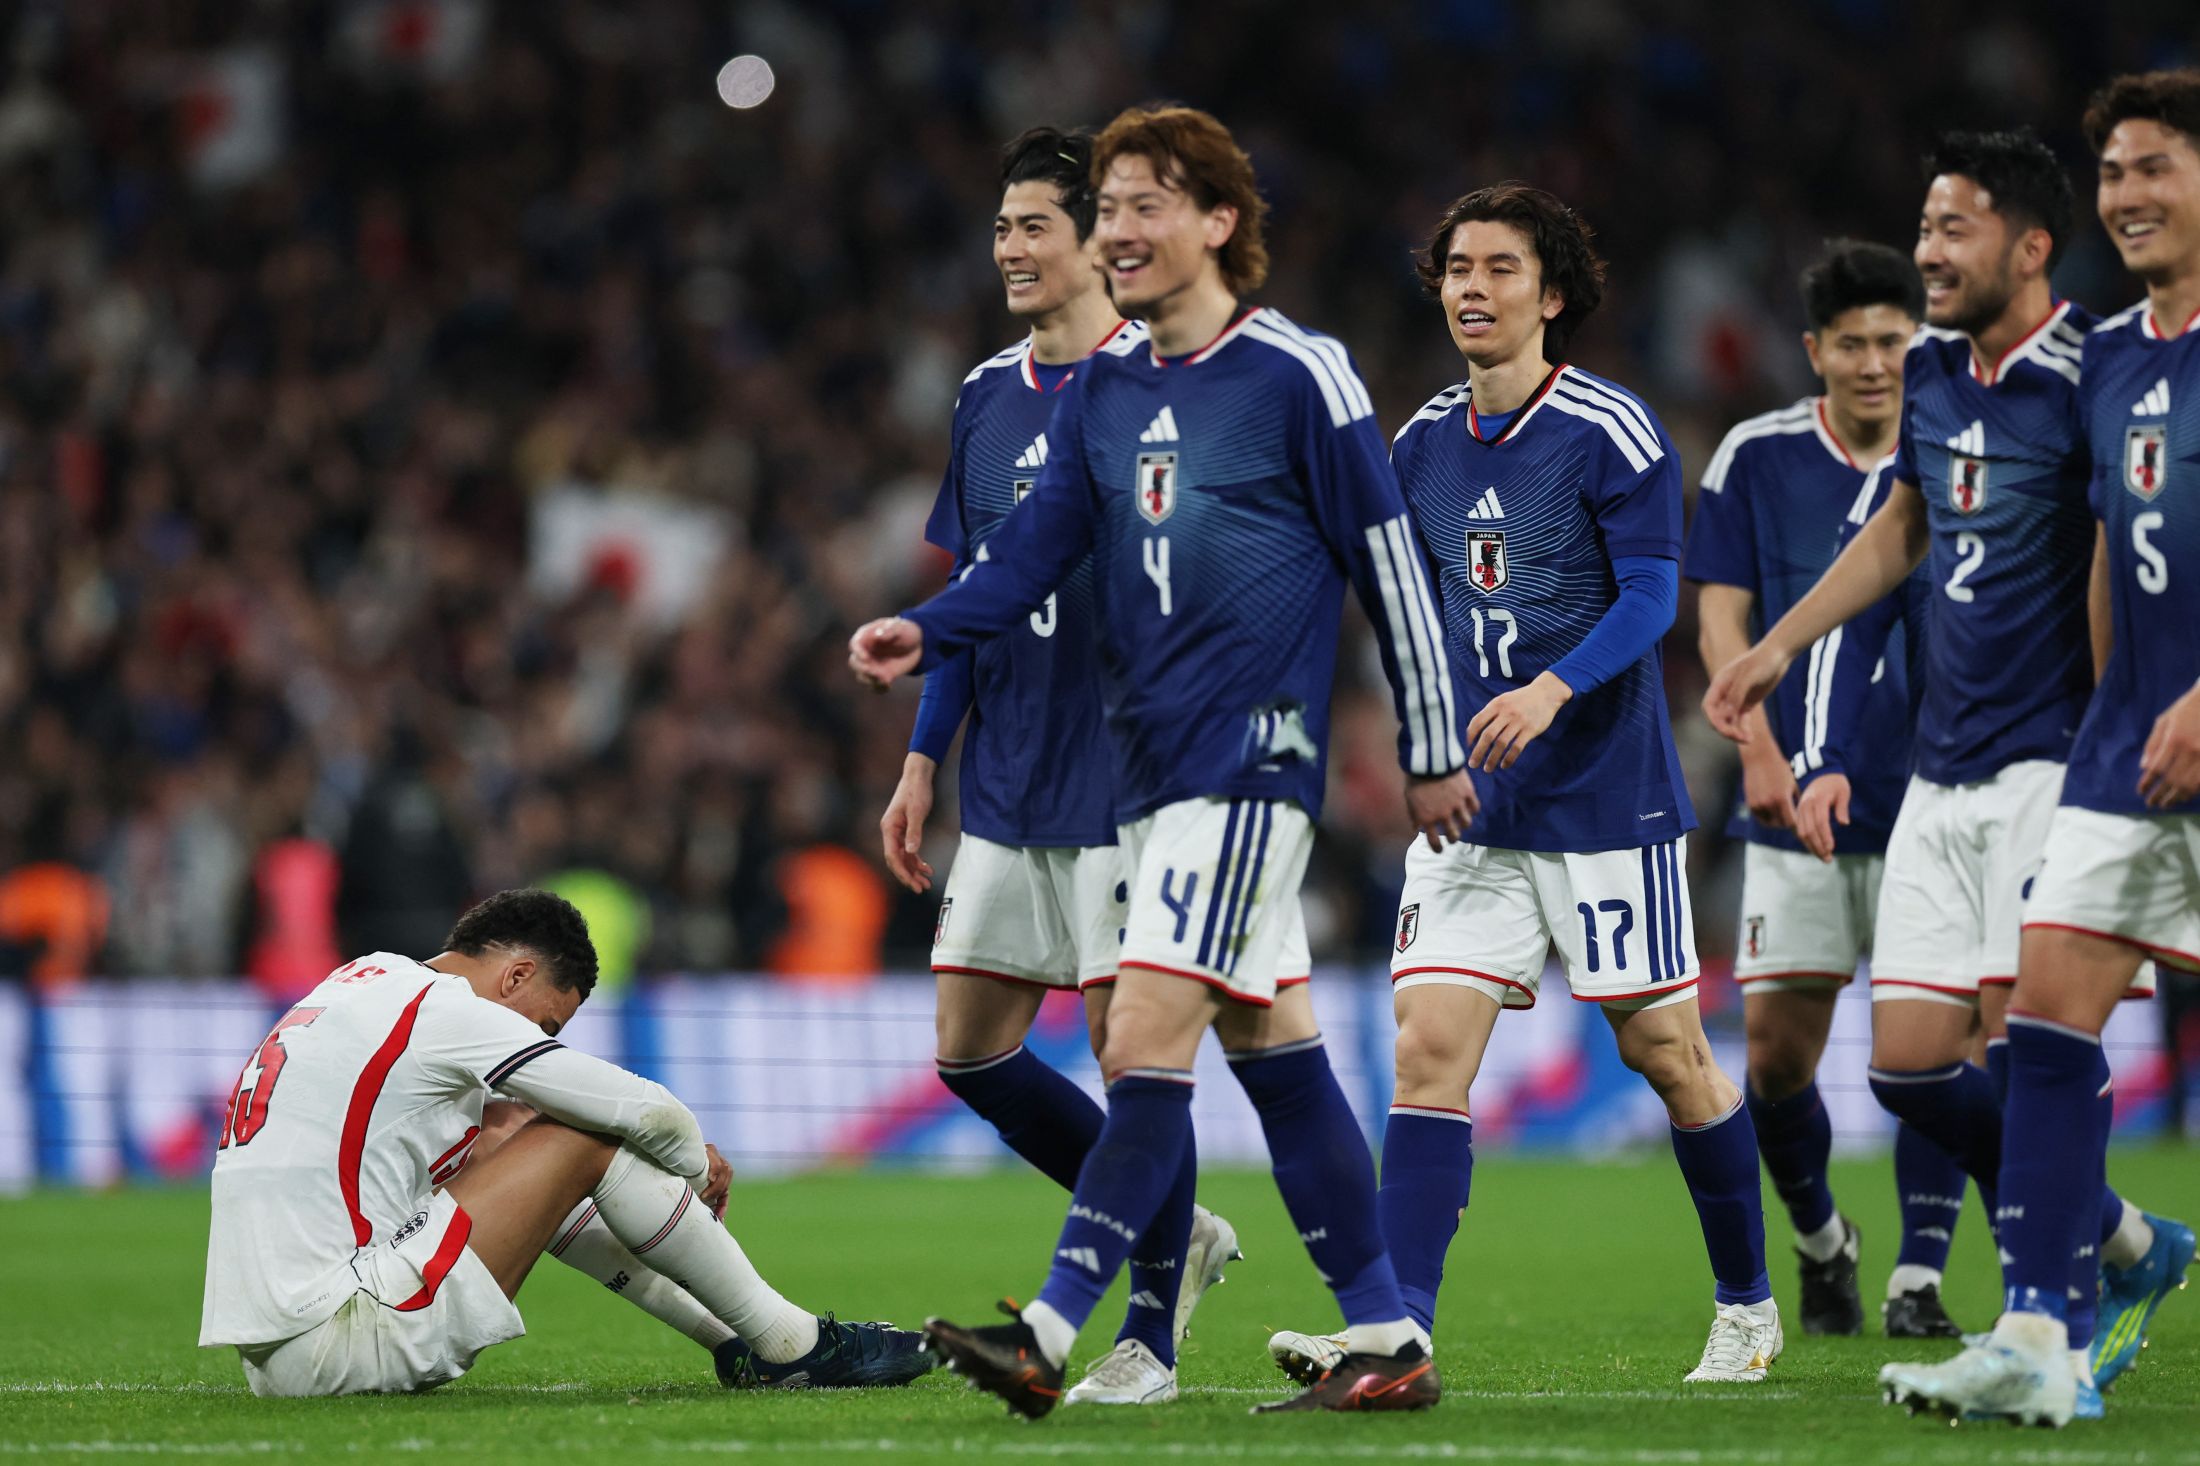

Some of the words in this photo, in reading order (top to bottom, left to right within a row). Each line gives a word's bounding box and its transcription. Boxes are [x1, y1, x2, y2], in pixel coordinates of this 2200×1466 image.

[1143, 536, 1172, 616] 4
[1945, 532, 1985, 603] 2
[2132, 511, 2168, 594] 5
[1471, 607, 1518, 678] 17
[1161, 868, 1198, 943] 4
[1577, 899, 1634, 972] 17
[1069, 1203, 1137, 1243] JAPAN
